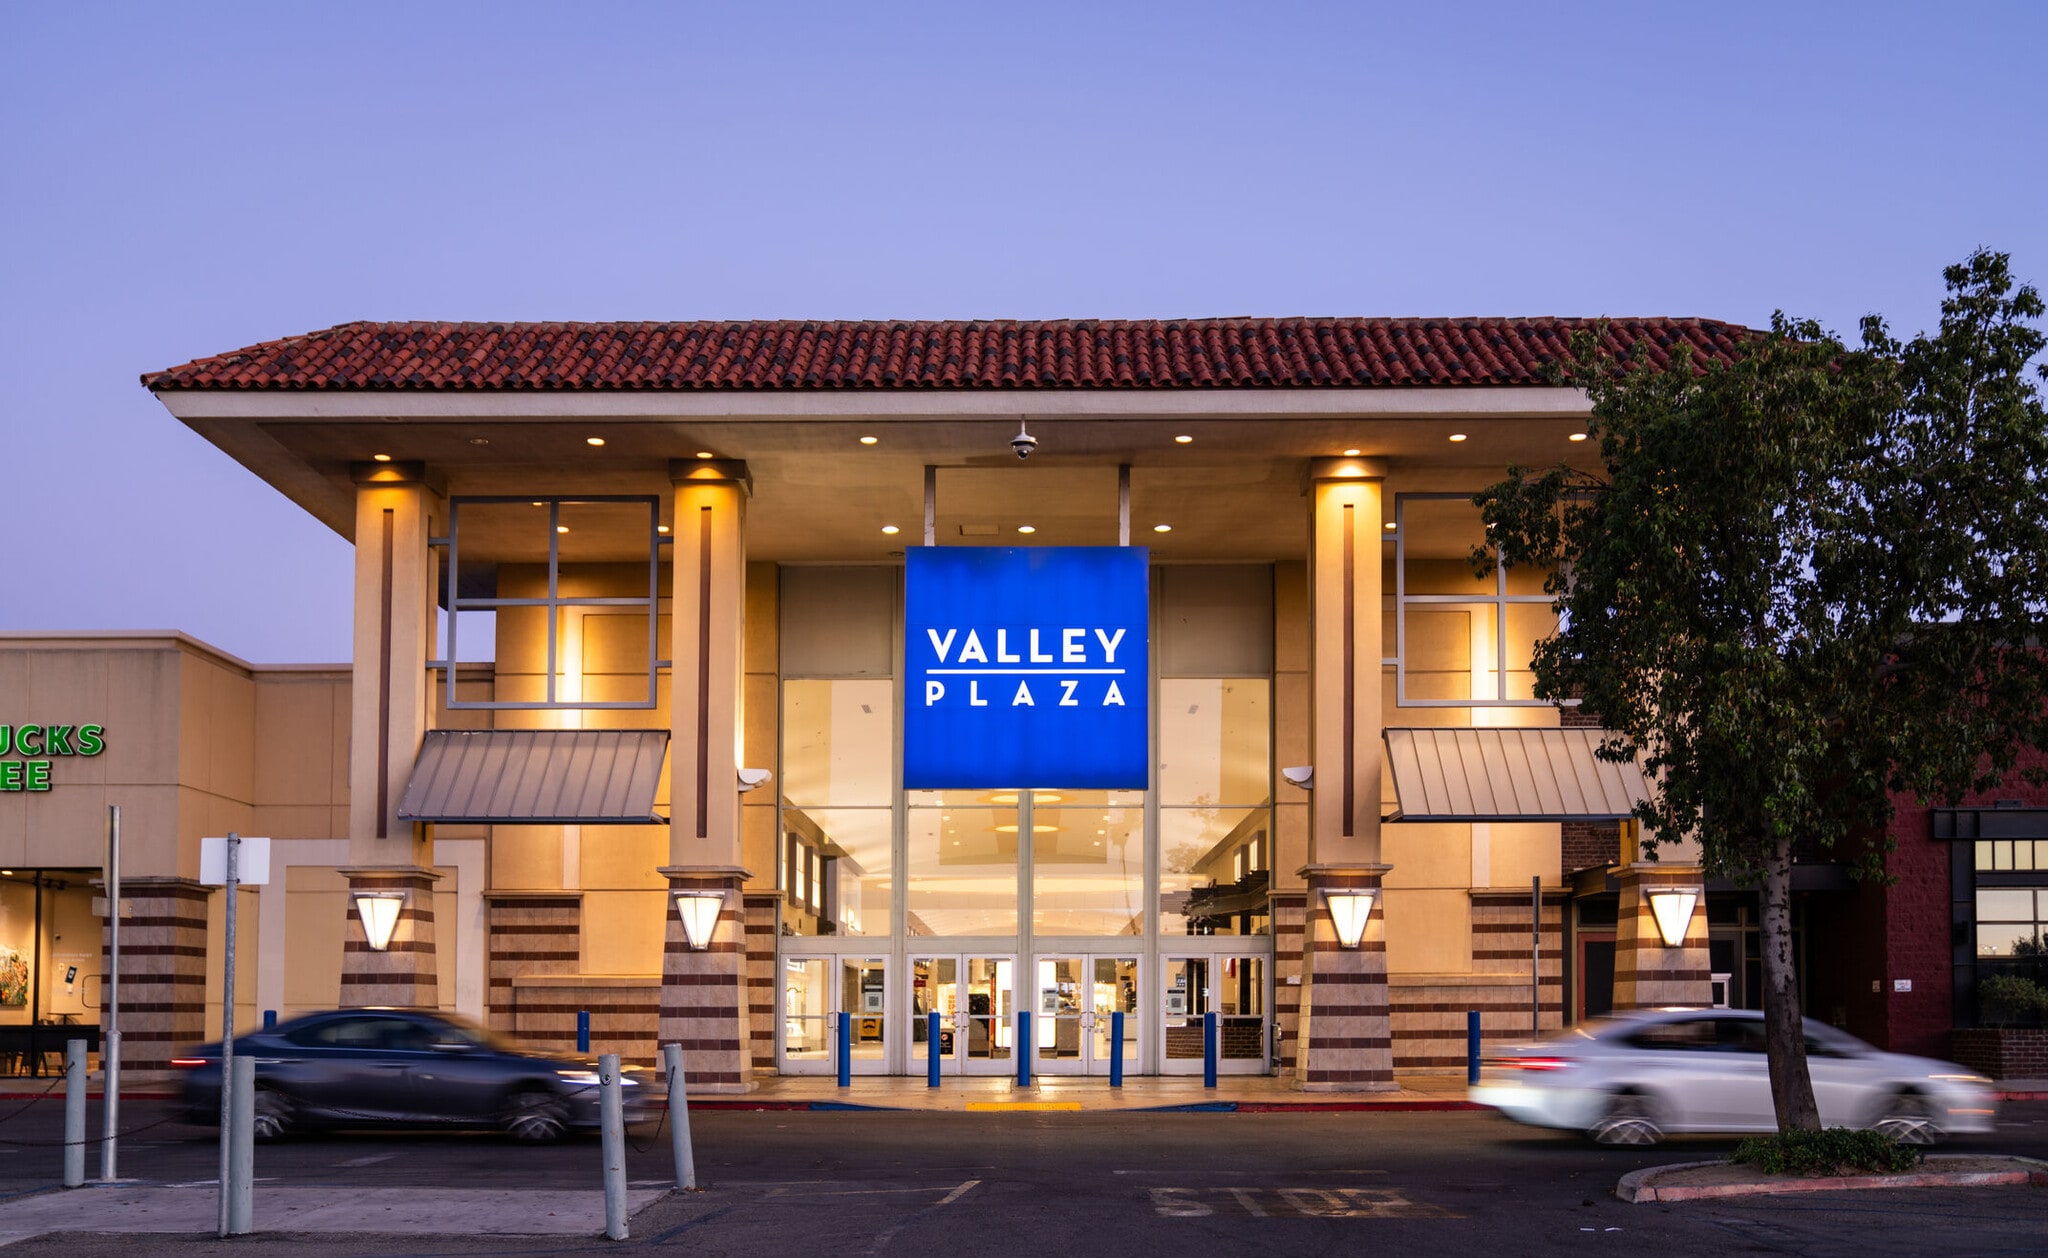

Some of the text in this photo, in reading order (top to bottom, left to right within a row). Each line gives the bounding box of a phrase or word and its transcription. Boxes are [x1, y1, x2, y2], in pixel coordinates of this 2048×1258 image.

[926, 628, 1126, 663] VALLEY
[925, 680, 1126, 706] PLAZA
[0, 760, 50, 791] EE
